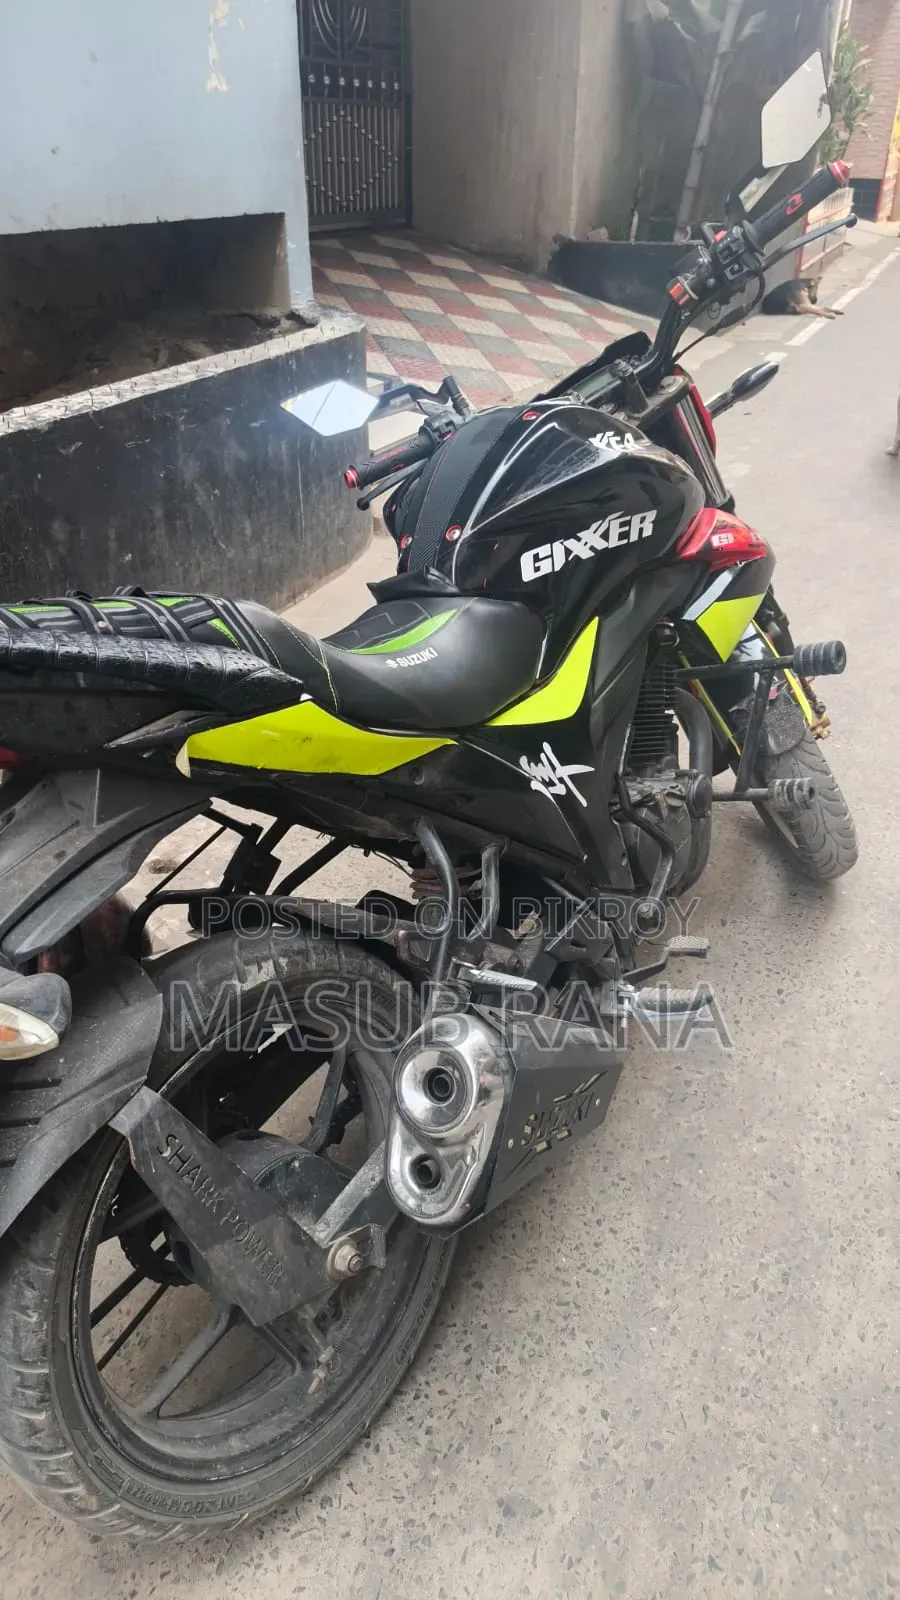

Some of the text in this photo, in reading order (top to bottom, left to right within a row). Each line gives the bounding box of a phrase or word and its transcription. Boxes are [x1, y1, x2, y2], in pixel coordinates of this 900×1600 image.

[520, 509, 657, 583] GIXXER
[395, 647, 438, 667] SUZUKI
[520, 1091, 595, 1147] SUZUKI
[156, 1133, 286, 1289] SHARK POWER
